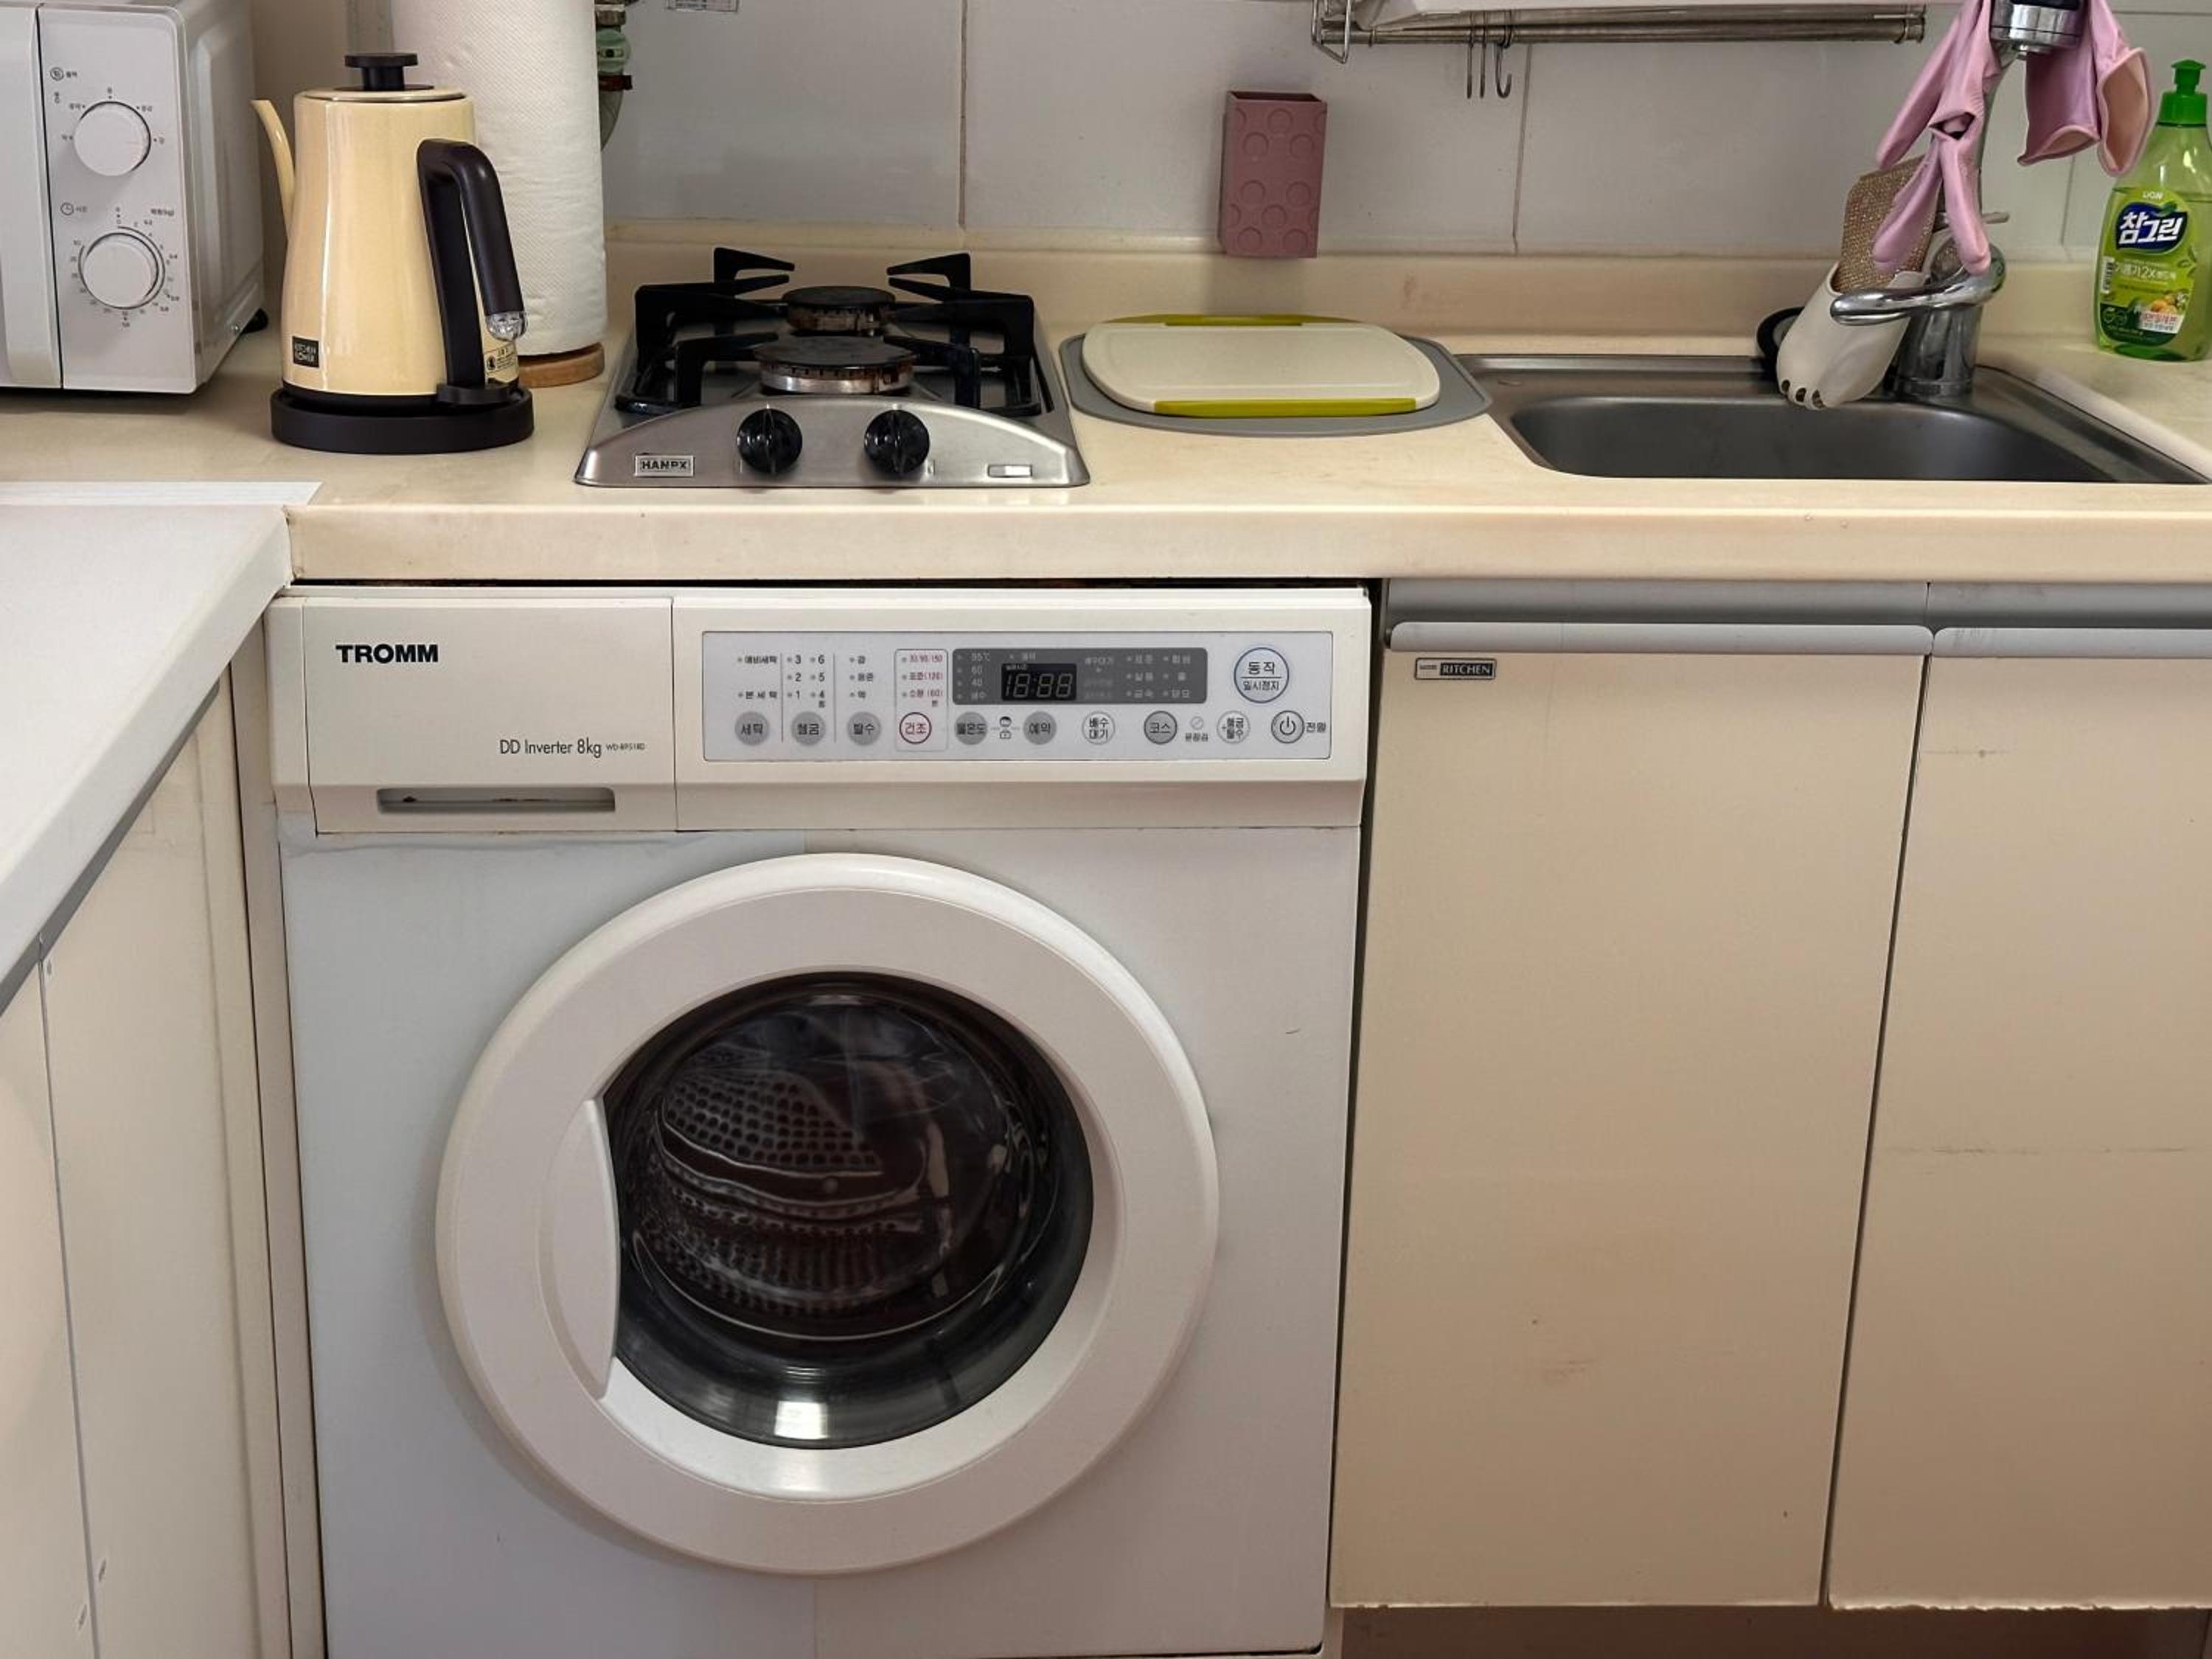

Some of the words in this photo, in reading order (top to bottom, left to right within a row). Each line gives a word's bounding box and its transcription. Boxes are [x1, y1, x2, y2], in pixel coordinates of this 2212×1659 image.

[2119, 212, 2183, 245] 참그린
[336, 644, 439, 664] TROMM
[795, 654, 801, 664] 3
[818, 654, 825, 664] 6
[1248, 661, 1276, 675] 동작
[795, 672, 801, 682] 2
[818, 672, 825, 682] 5
[1243, 680, 1279, 692] 일시정지
[796, 689, 801, 700] 1
[819, 689, 825, 699] 4
[1089, 717, 1109, 728] 배수
[1150, 722, 1172, 734] 코스
[1306, 721, 1326, 733] 전원
[741, 723, 763, 735] 세탁
[797, 723, 819, 735] 헹굼
[854, 723, 874, 736] 탈수
[905, 723, 927, 735] 건조
[1089, 729, 1108, 739] 대기
[500, 740, 521, 754] DD
[524, 739, 573, 754] Inverter
[577, 737, 602, 759] 8kg
